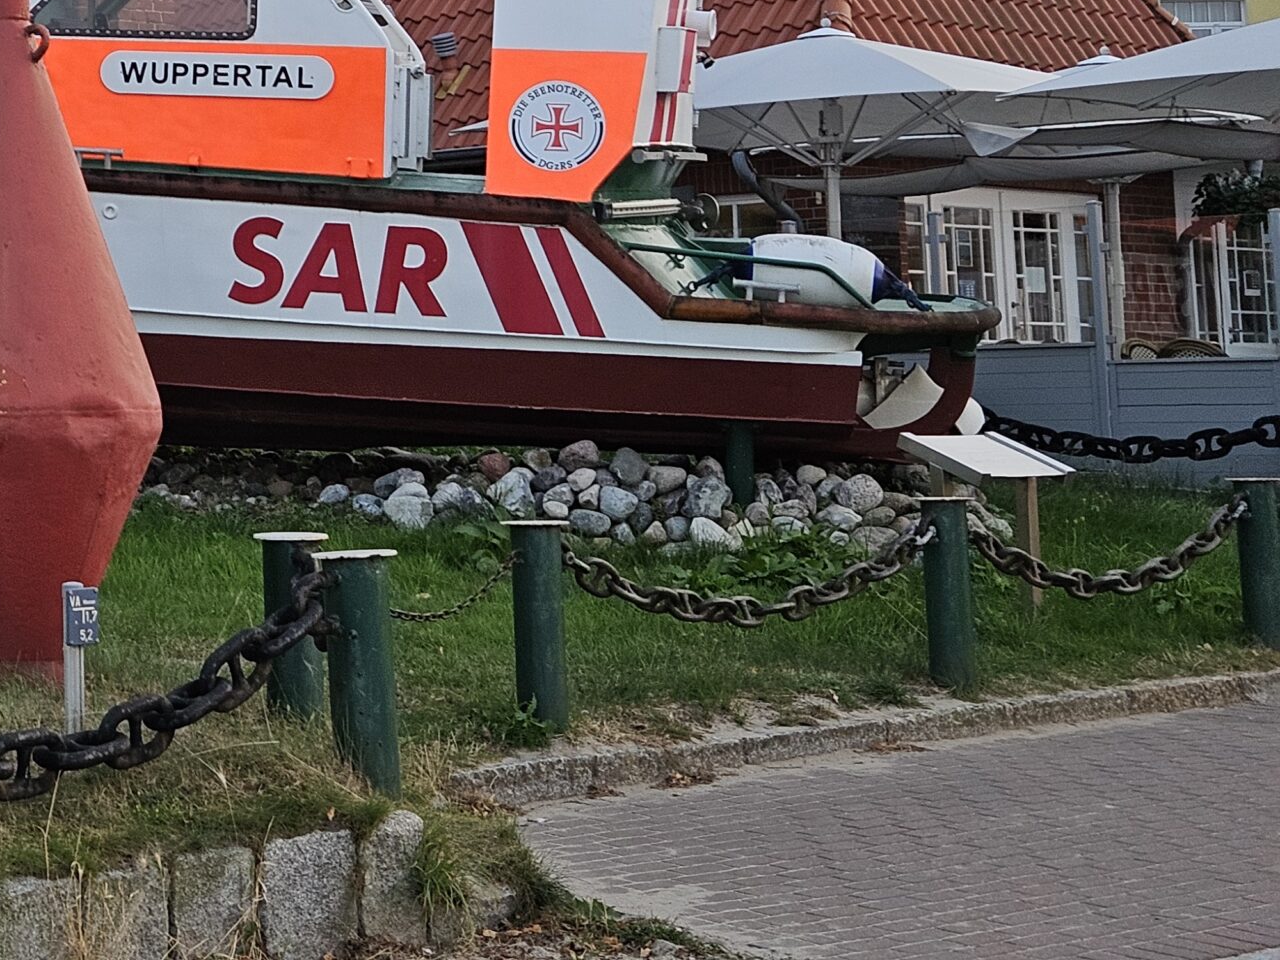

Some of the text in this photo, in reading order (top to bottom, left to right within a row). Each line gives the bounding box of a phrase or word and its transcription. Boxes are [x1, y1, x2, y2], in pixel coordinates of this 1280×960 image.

[119, 60, 316, 90] WUPPERTAL
[513, 84, 603, 121] DIE SEENOTRETTER
[538, 158, 574, 171] DGzRS
[227, 215, 450, 318] SAR
[69, 595, 81, 608] VA
